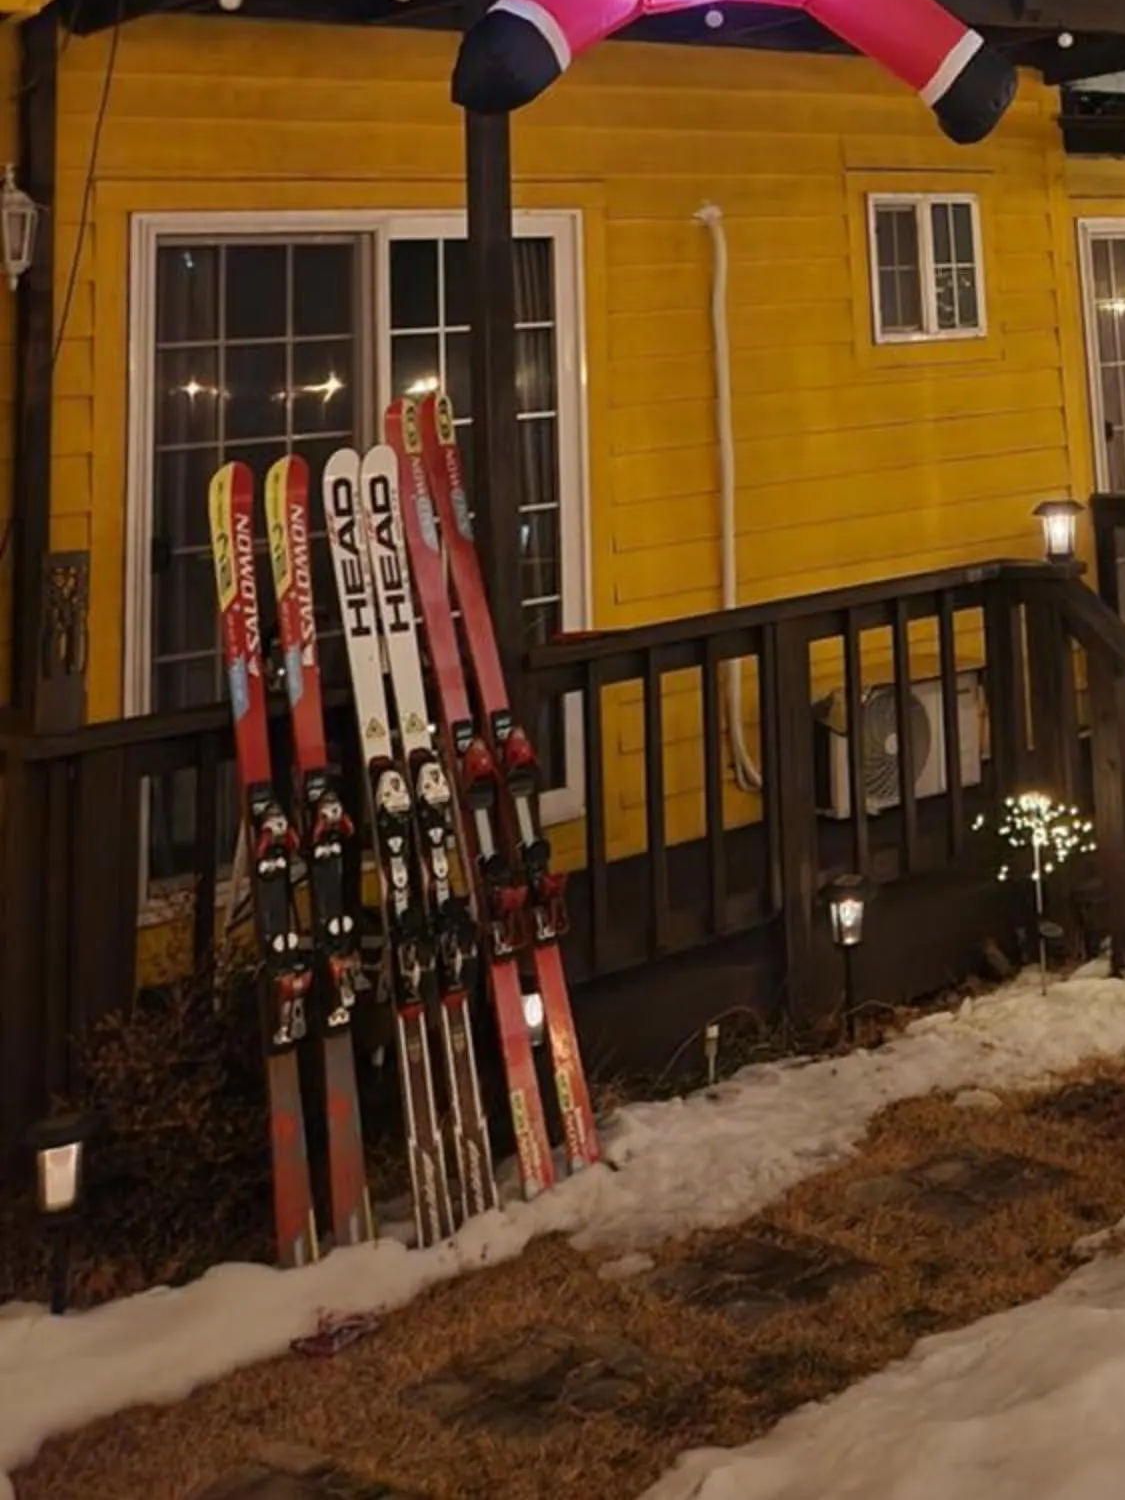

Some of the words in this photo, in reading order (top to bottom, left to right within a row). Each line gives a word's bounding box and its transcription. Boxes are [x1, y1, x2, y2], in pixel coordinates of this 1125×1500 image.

[234, 513, 261, 653] SALOMON
[289, 504, 317, 645] SALOMON
[333, 477, 371, 637] HEAD
[369, 474, 409, 633] HEAD
